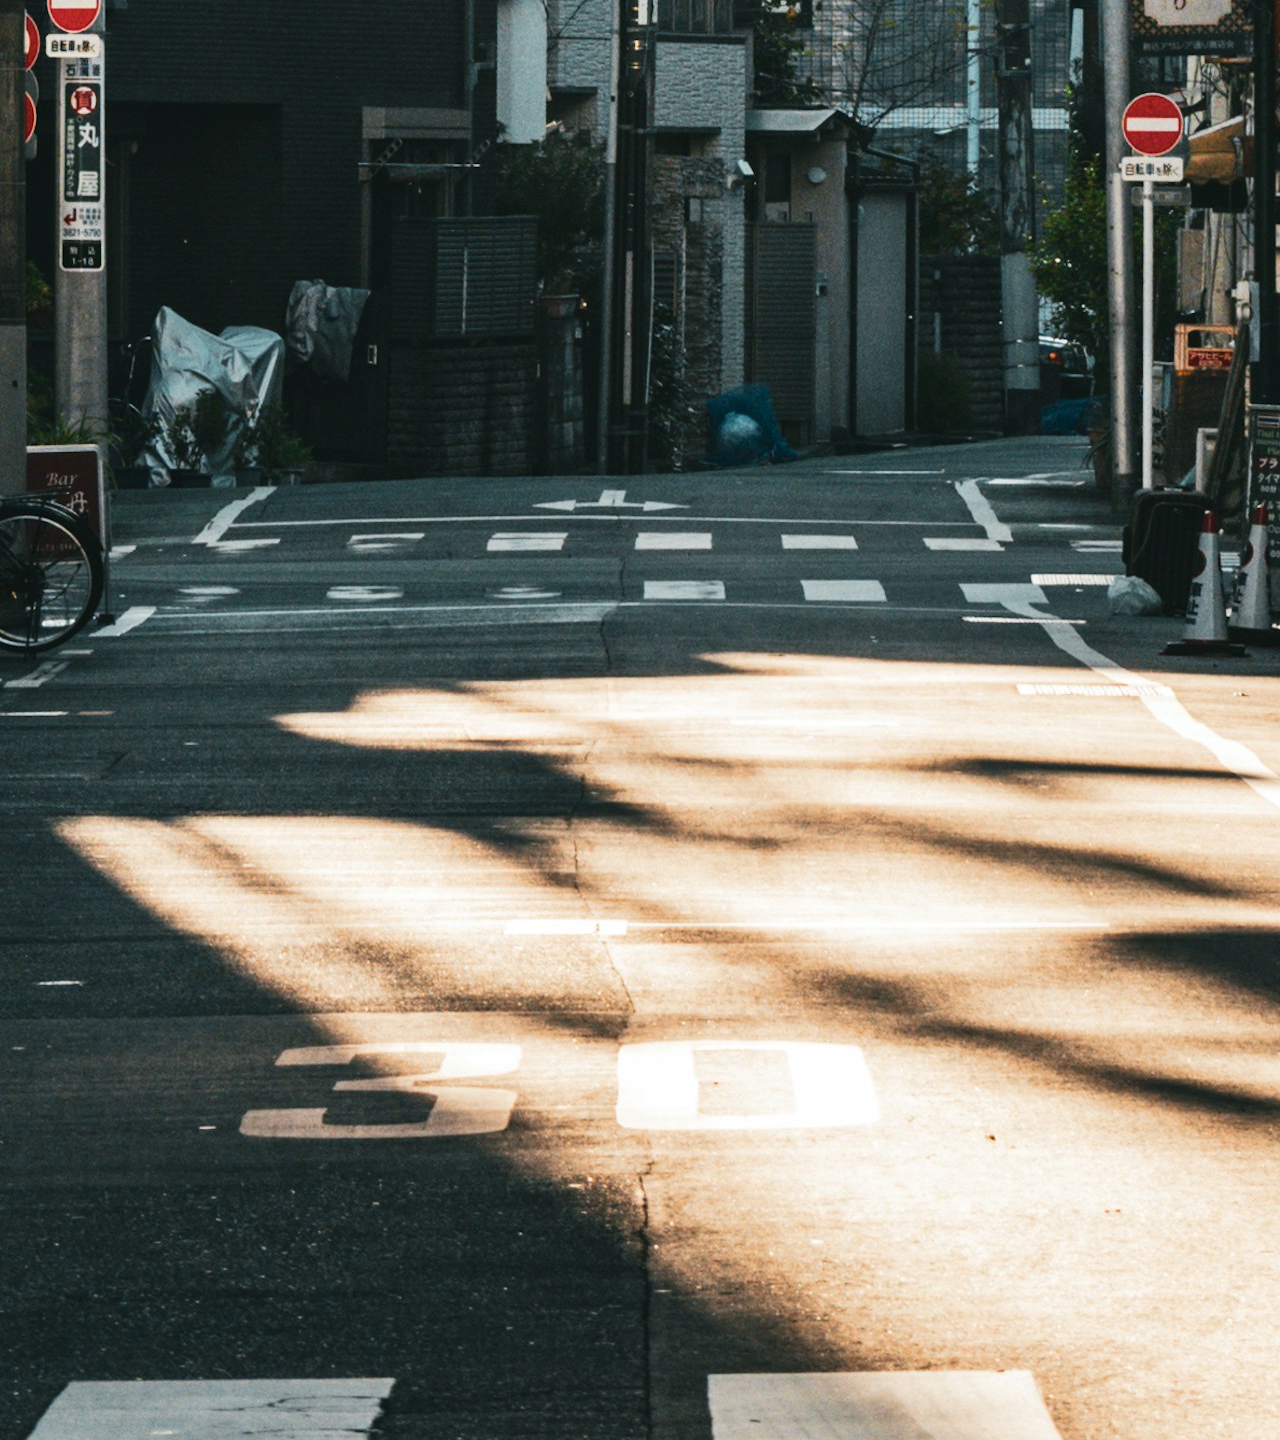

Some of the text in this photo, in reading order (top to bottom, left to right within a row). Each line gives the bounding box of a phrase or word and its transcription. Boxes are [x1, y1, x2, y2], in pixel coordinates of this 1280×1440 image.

[51, 39, 96, 52] 自転車を除く
[1125, 163, 1179, 176] 自転車を除く
